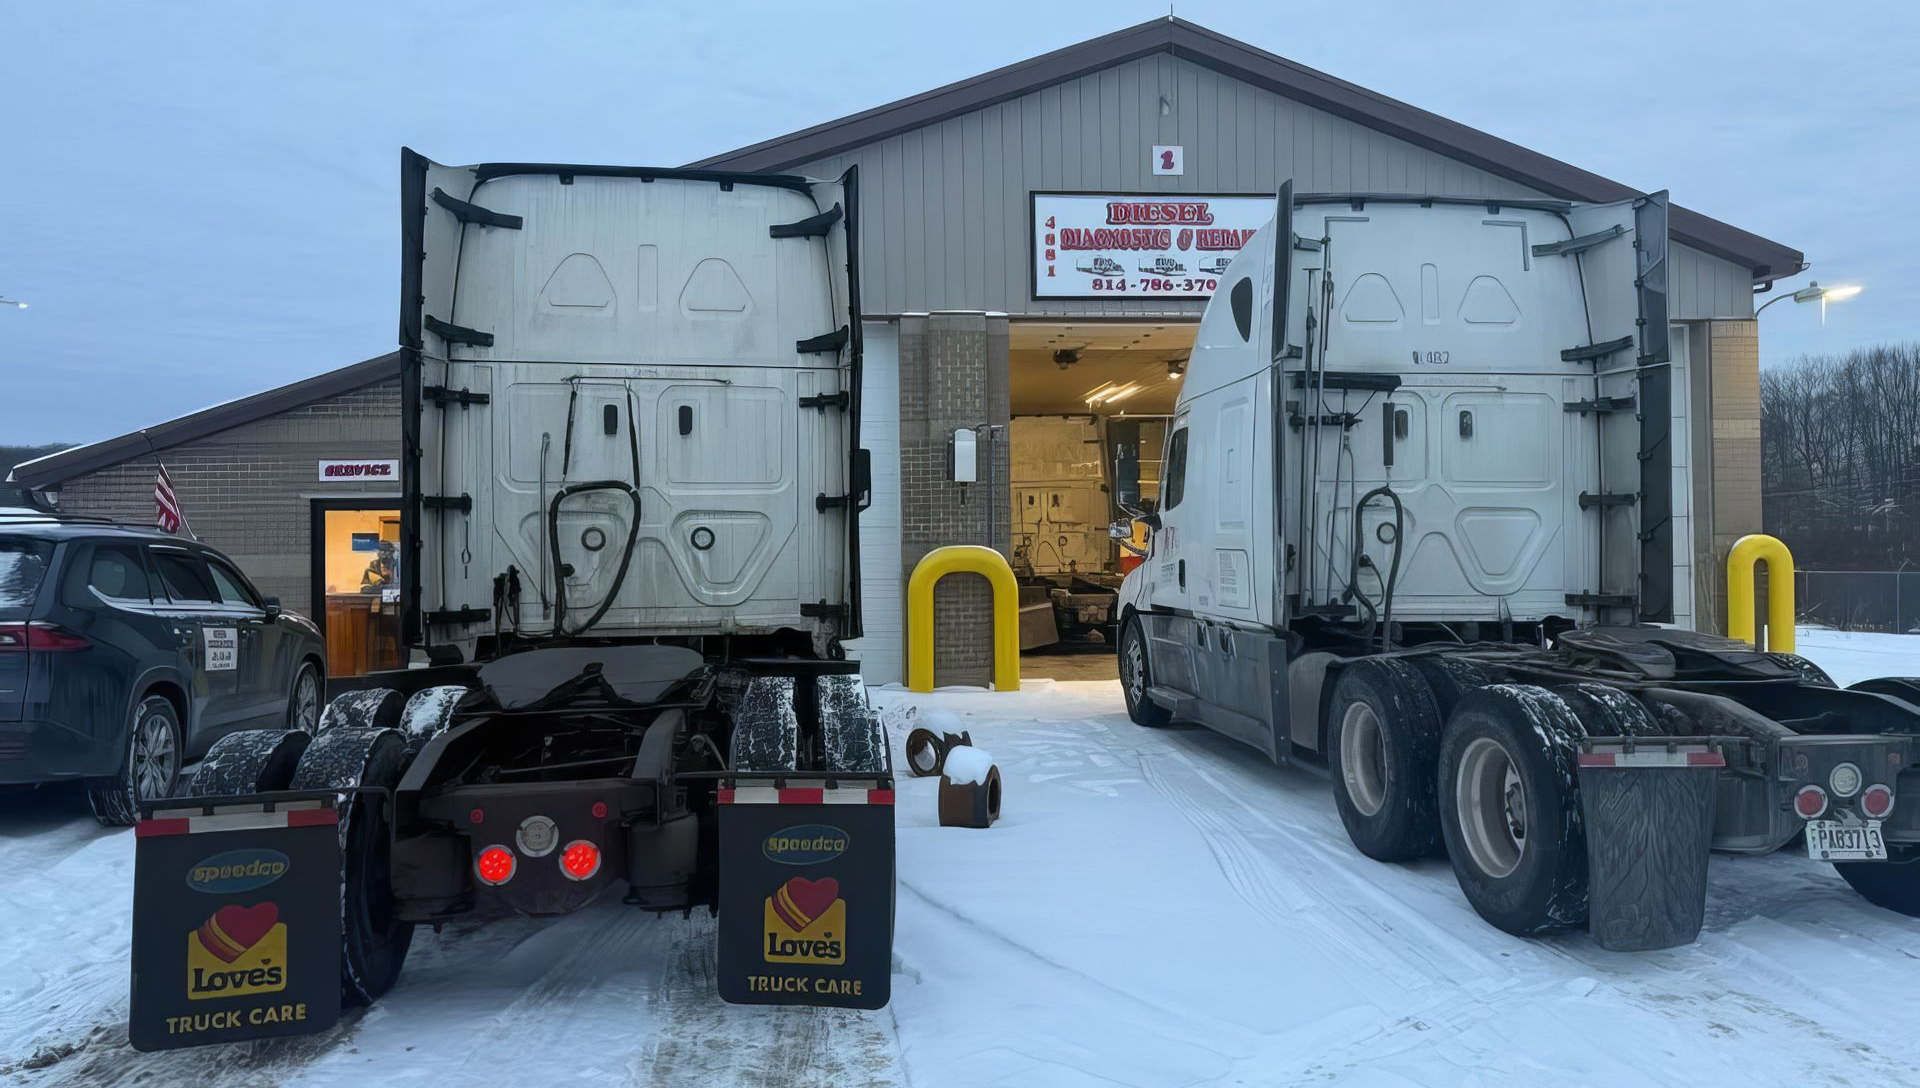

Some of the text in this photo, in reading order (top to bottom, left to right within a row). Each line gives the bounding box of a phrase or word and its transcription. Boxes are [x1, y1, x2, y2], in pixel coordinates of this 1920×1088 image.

[1106, 202, 1214, 226] DIESEL
[1060, 228, 1171, 251] DIAGNOSTIC
[1092, 278, 1218, 292] 814-786-370
[325, 464, 392, 477] SERVICE
[747, 976, 863, 996] TRUCK CARE
[166, 1003, 307, 1035] TRUCK CARE
